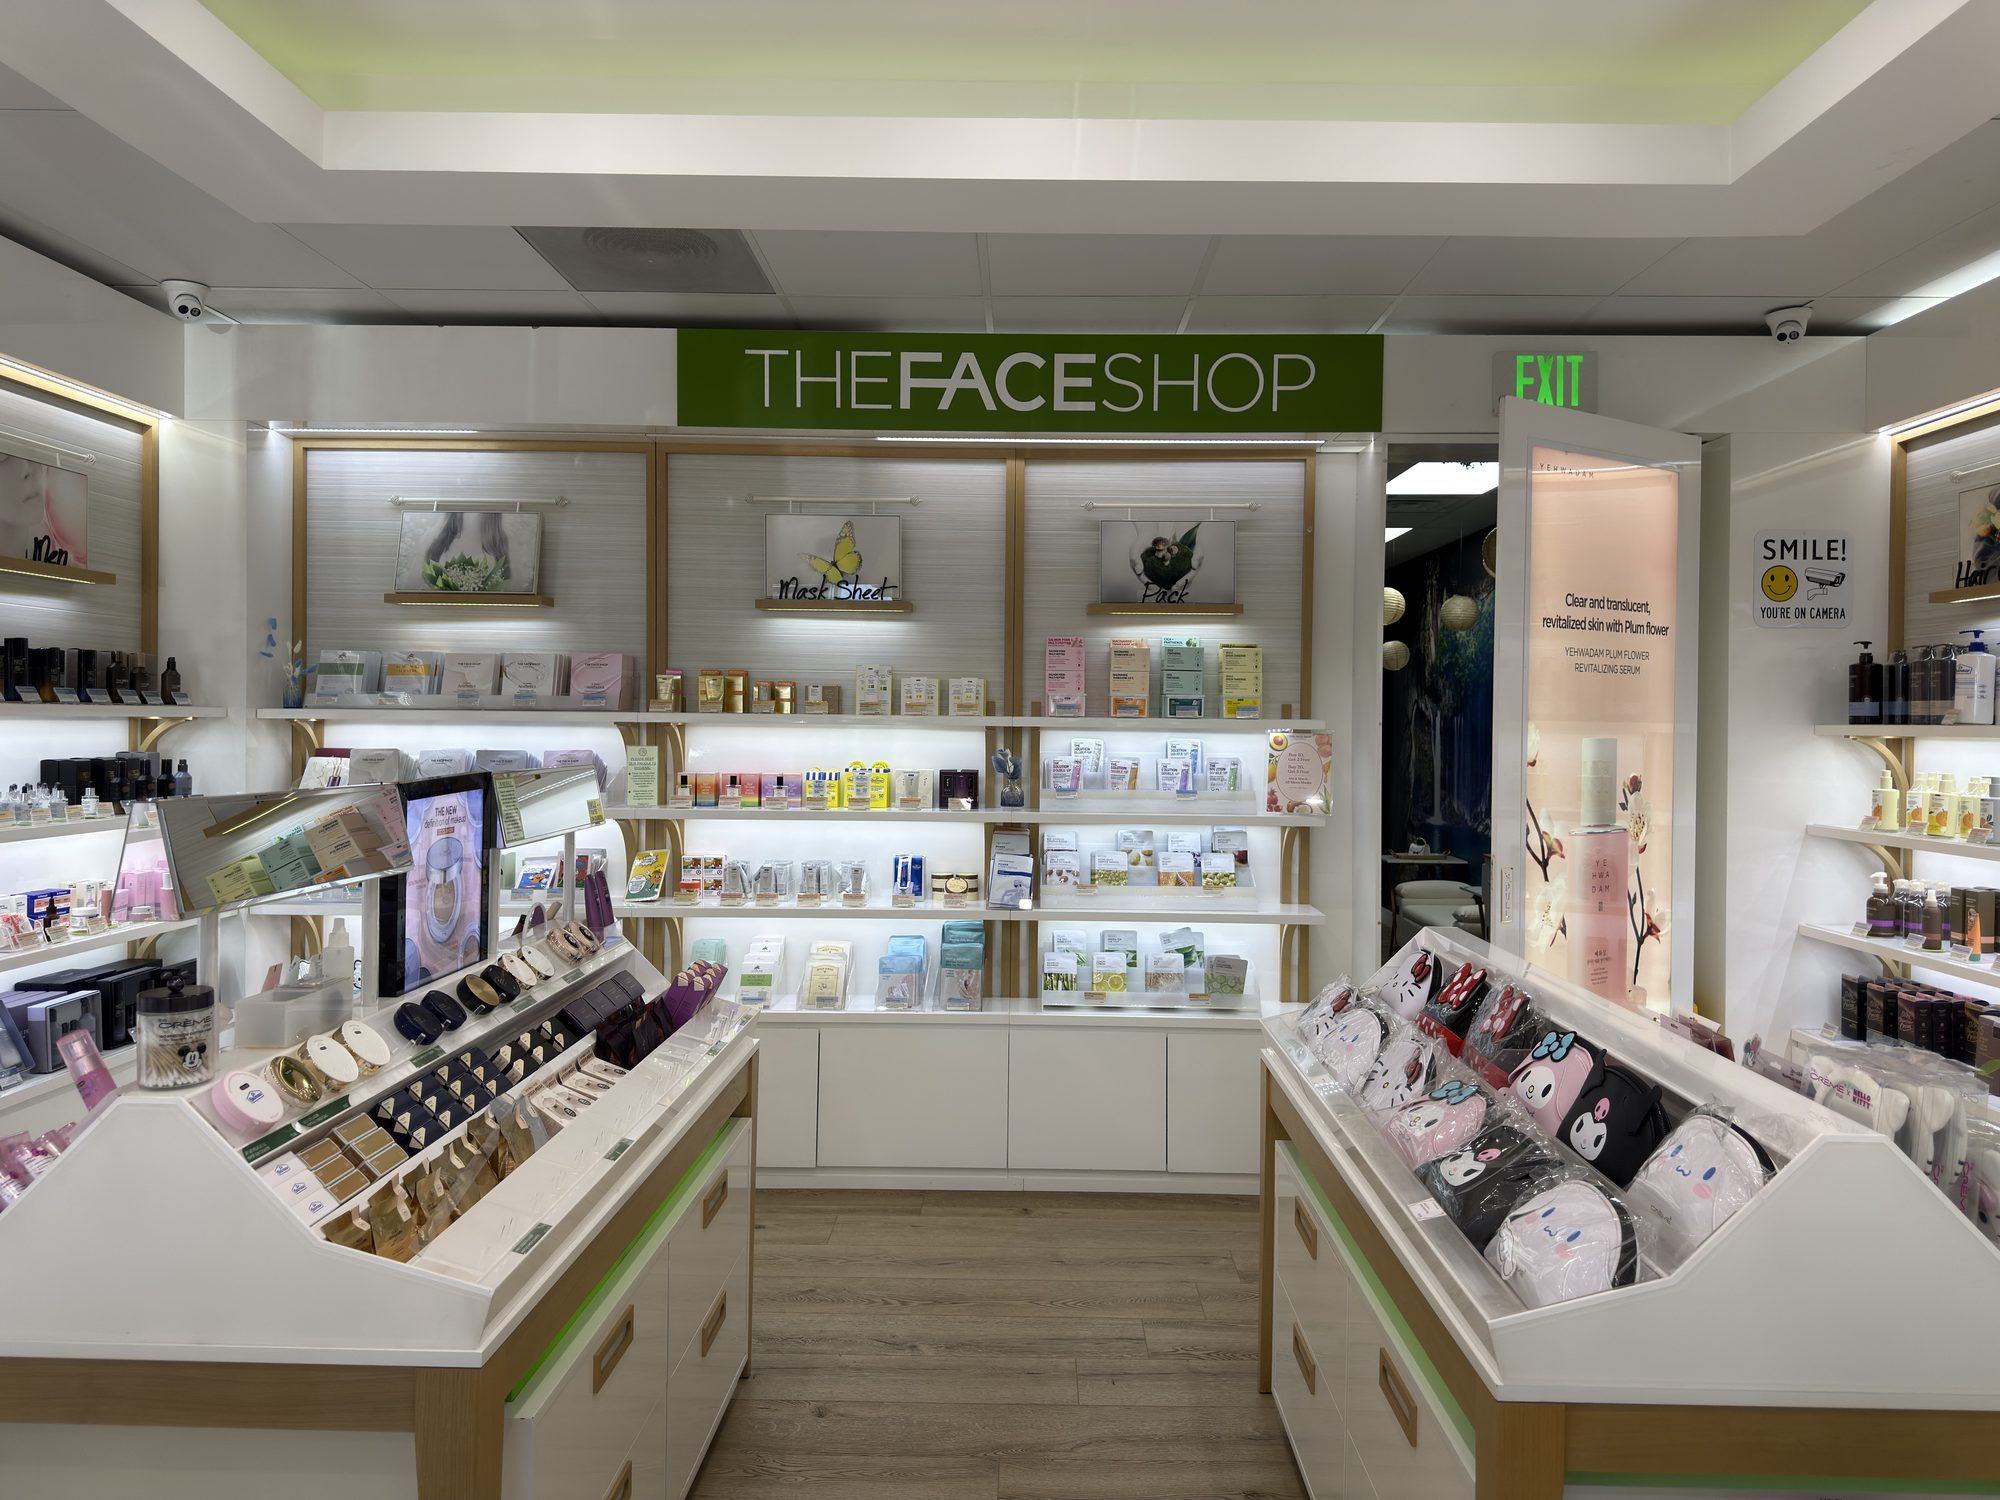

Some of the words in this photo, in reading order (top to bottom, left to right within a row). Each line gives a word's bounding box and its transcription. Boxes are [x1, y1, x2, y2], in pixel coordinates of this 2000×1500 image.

[1516, 355, 1584, 407] EXIT
[32, 535, 68, 566] Men
[1762, 539, 1846, 561] SMILE!
[1955, 560, 1997, 588] Hair
[779, 574, 829, 600] Mask
[834, 574, 898, 600] Sheet
[1142, 579, 1189, 603] Pack
[1565, 593, 1587, 608] Clear
[1589, 596, 1605, 609] and
[1606, 597, 1651, 615] translucent,
[1760, 607, 1791, 619] YOU'RE
[1794, 607, 1806, 619] ON
[1810, 607, 1846, 619] CAMERA
[1542, 614, 1586, 630] revitalized
[1588, 617, 1604, 632] skin
[1606, 618, 1623, 633] with
[1625, 620, 1645, 635] Plum
[1646, 622, 1669, 636] flower
[1565, 647, 1605, 659] YEHWADAM
[1605, 649, 1623, 660] PLUM
[1623, 650, 1650, 660] FLOWER
[1574, 663, 1619, 674] REVITALIZING
[1619, 665, 1641, 675] SERUM
[435, 807, 444, 816] THE
[446, 806, 457, 815] NEW
[1852, 1096, 1871, 1109] KITTY
[1853, 1088, 1871, 1102] HELLO
